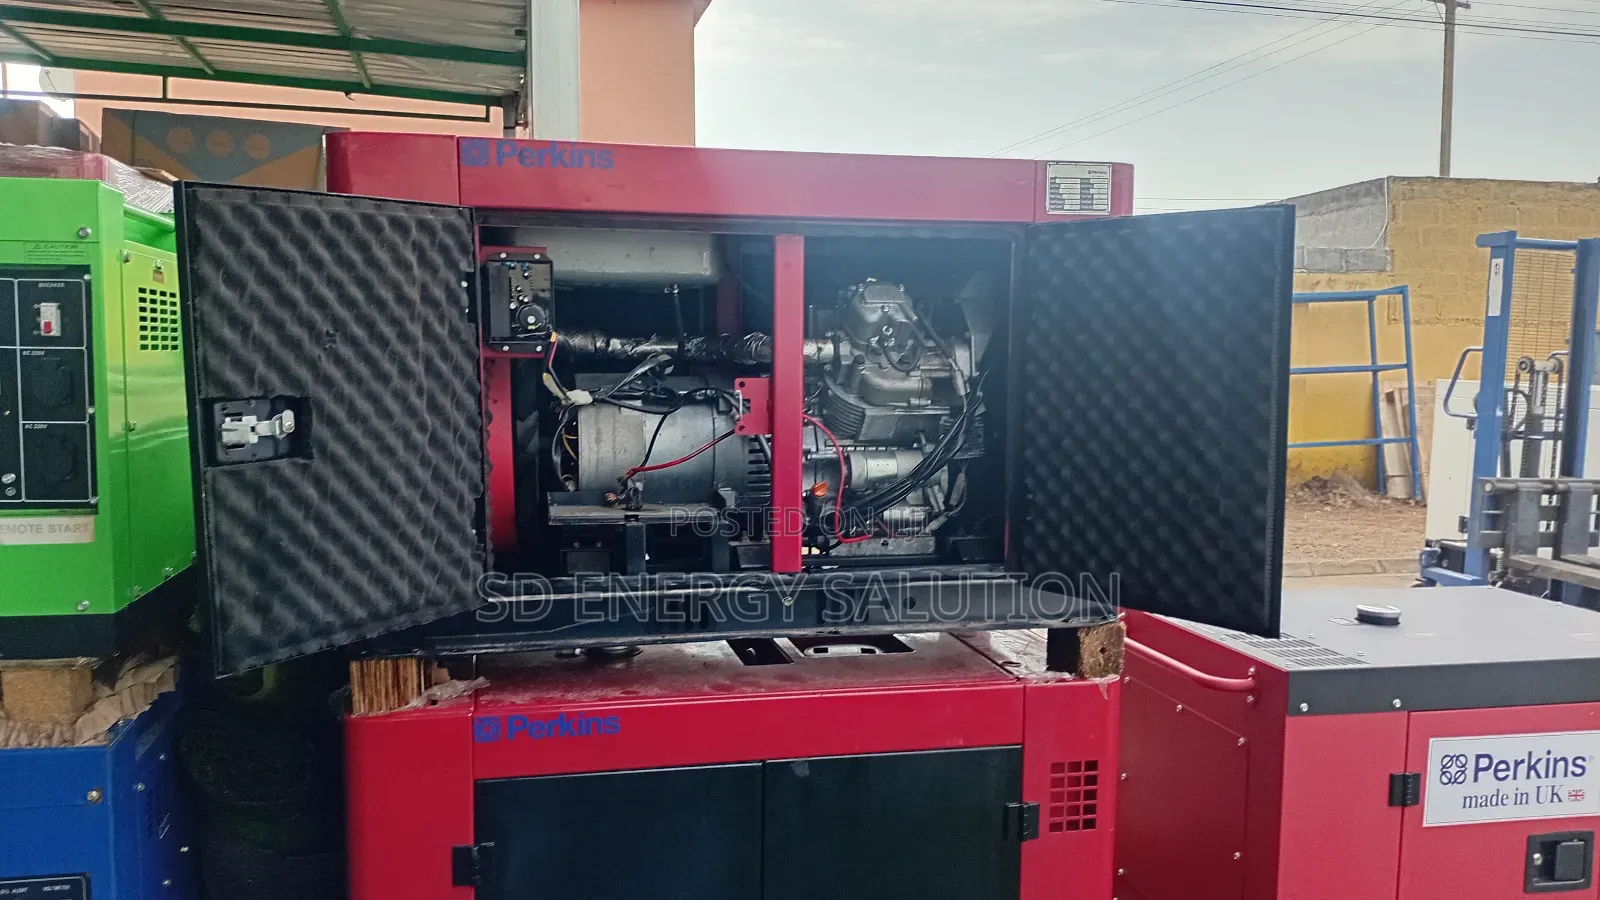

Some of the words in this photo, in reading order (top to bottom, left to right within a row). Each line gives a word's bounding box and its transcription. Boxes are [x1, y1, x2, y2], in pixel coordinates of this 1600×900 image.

[496, 139, 614, 170] Perkins
[47, 523, 89, 534] START
[507, 711, 621, 741] Perkins
[1473, 750, 1587, 783] Perkins
[1462, 788, 1509, 809] made
[1514, 787, 1530, 806] in
[1536, 784, 1564, 804] UK
